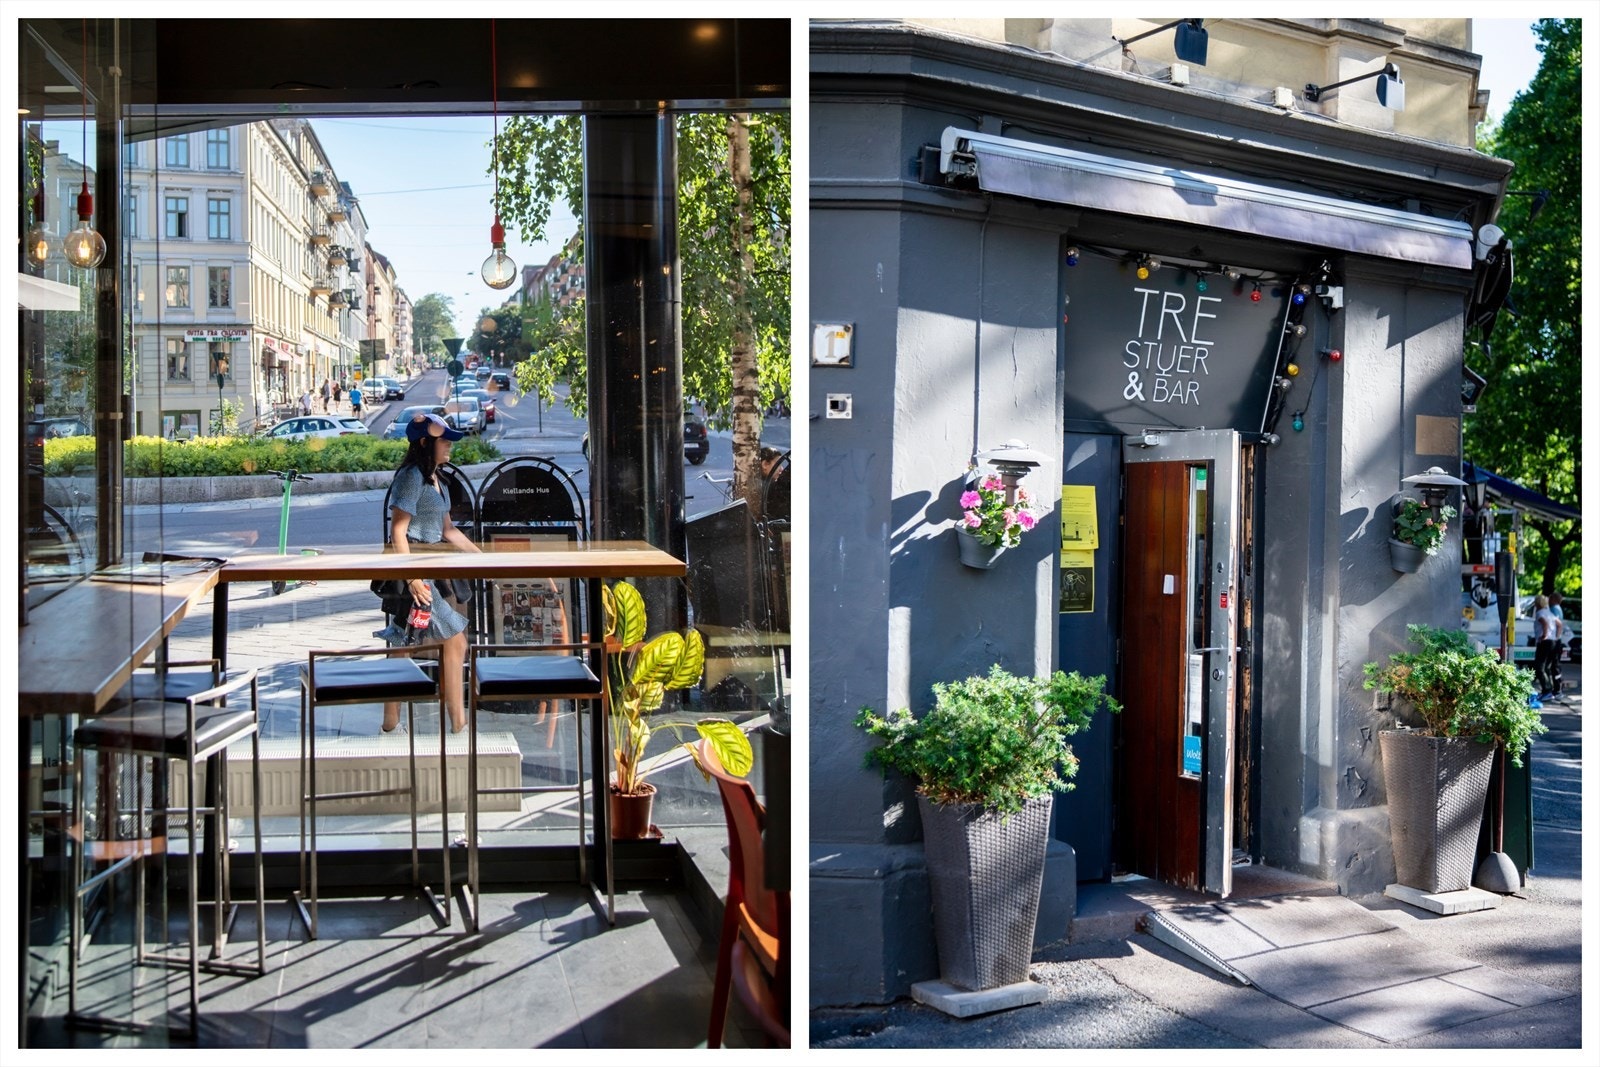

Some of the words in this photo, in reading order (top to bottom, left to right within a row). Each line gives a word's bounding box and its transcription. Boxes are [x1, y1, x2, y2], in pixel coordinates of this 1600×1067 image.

[1134, 287, 1222, 345] TRE
[825, 331, 837, 358] 1
[1123, 340, 1209, 376] STUER
[1123, 371, 1146, 401] &
[1153, 378, 1200, 405] BAR
